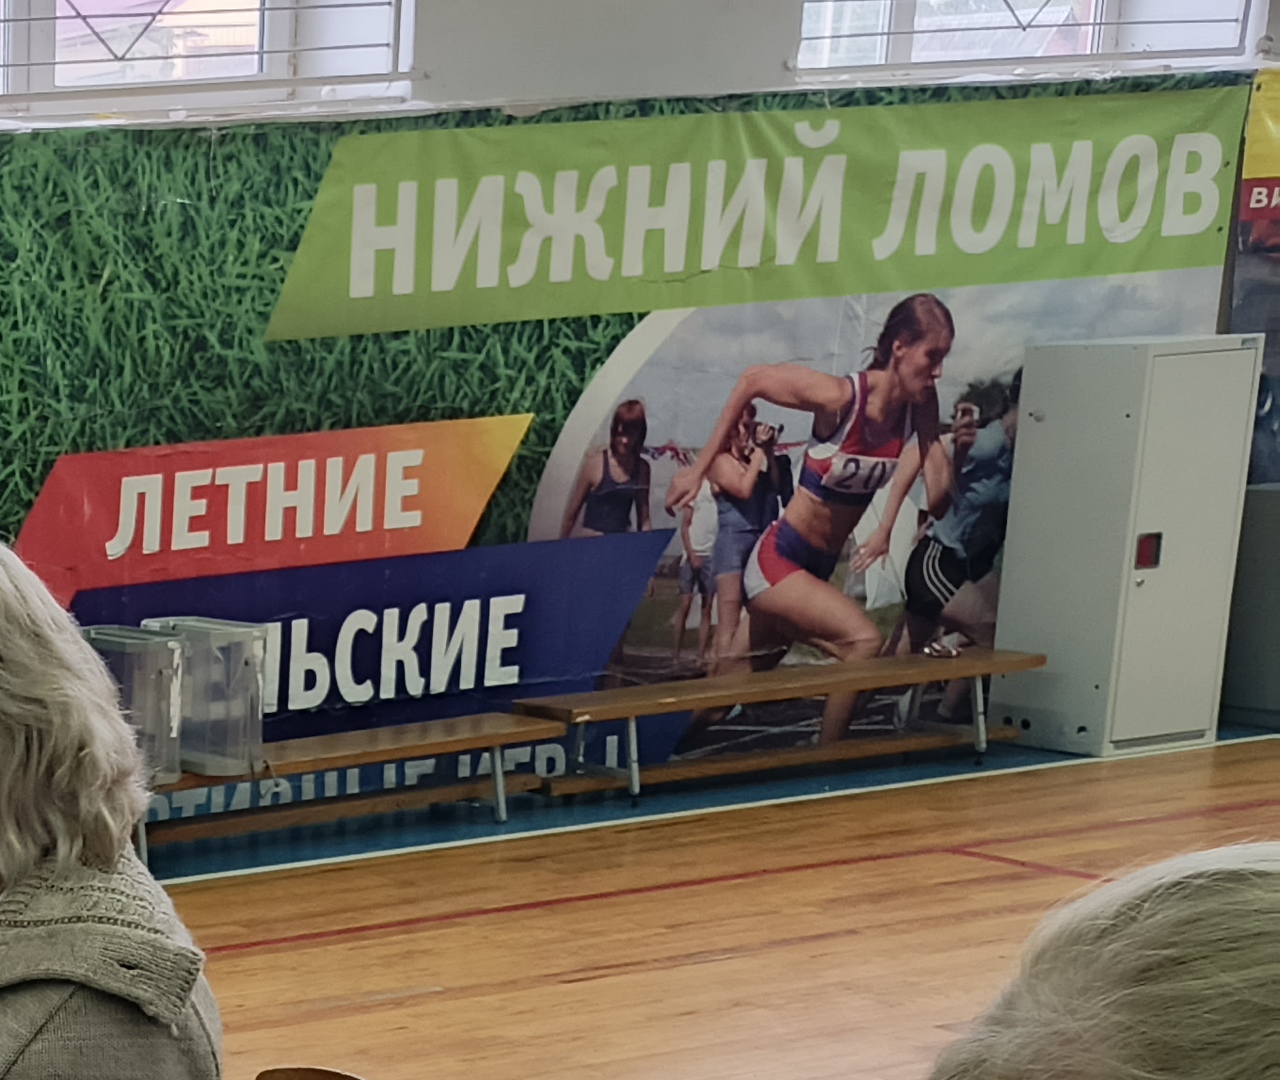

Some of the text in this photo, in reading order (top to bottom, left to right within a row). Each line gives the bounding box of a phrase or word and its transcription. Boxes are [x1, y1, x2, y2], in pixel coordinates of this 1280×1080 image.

[348, 119, 1224, 300] НИЖНИЙ ЛОМОВ
[104, 448, 425, 561] ЛЕТНИЕ
[835, 457, 897, 491] 20
